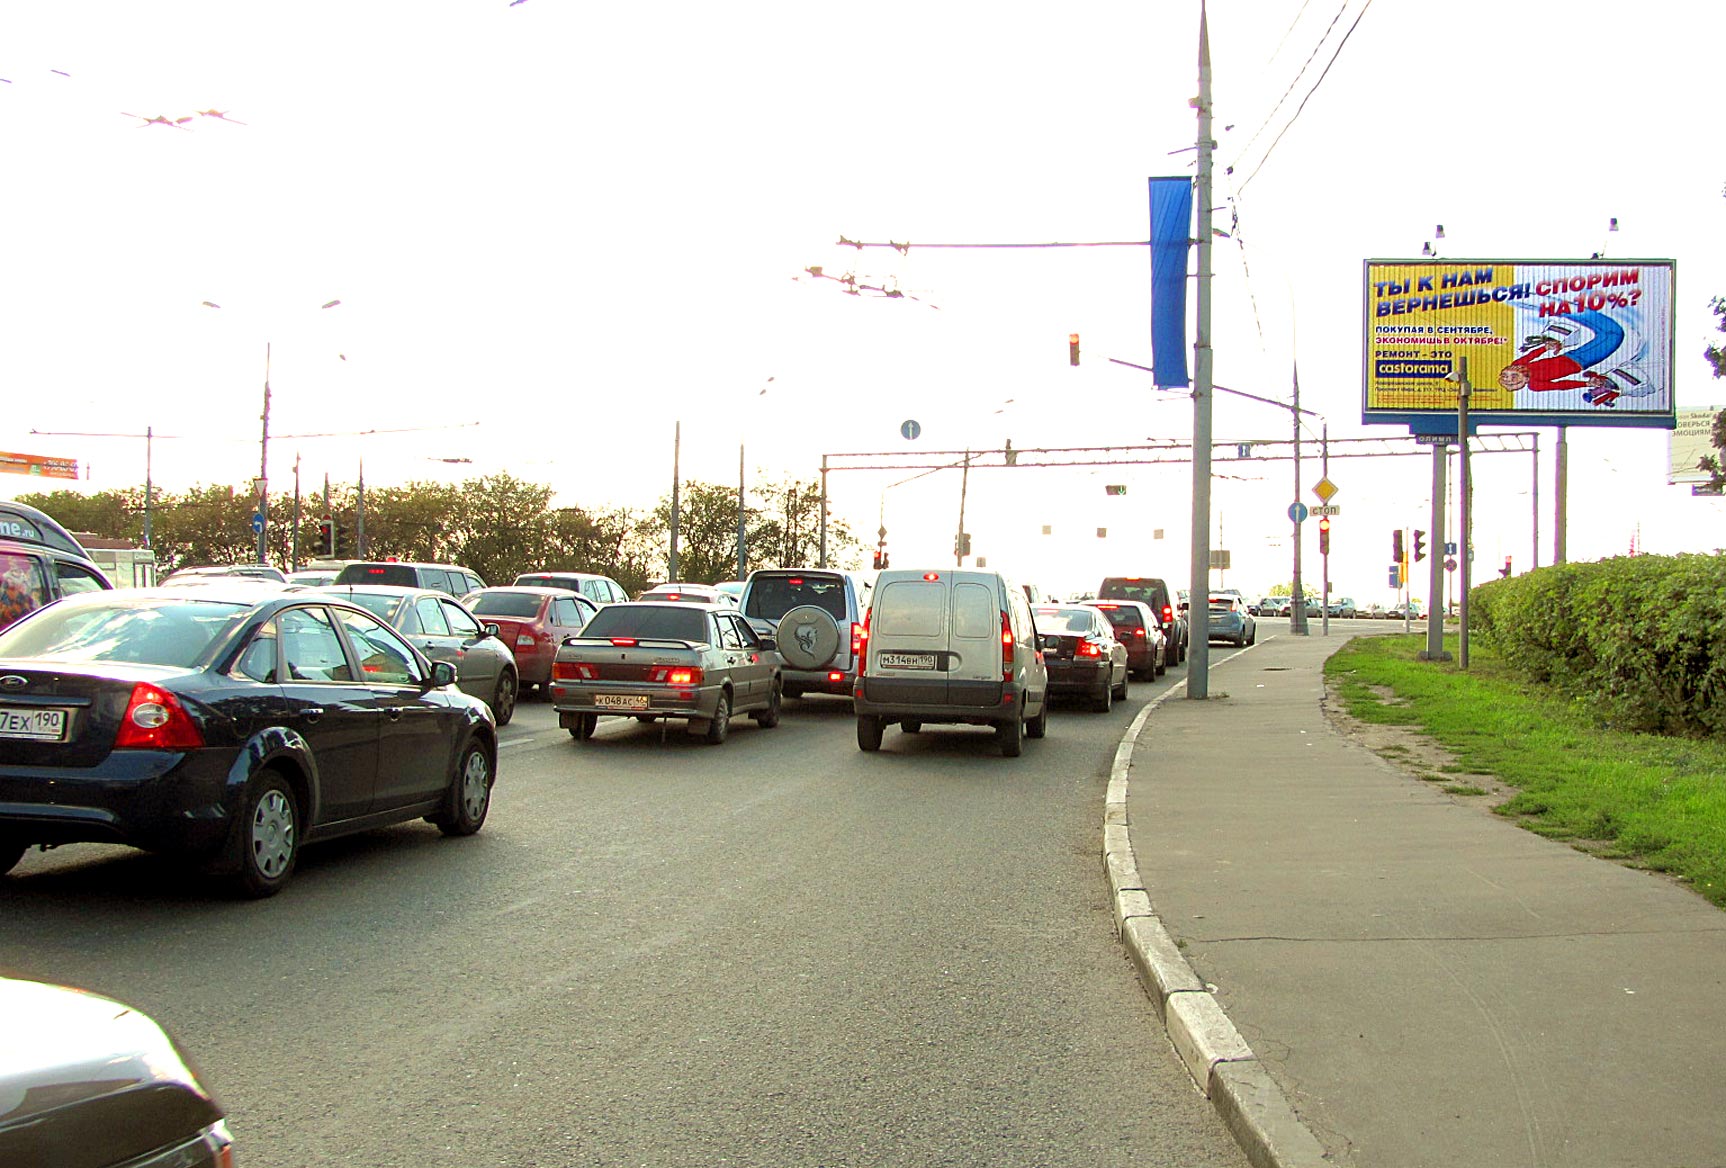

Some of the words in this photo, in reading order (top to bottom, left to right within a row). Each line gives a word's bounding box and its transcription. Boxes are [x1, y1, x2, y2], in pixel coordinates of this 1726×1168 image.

[1375, 279, 1410, 297] ТЫ
[1418, 275, 1434, 292] К
[1441, 267, 1493, 289] НАМ
[1535, 269, 1639, 296] СПОРИМ
[1376, 283, 1530, 317] ВЕРНЕШЬСЯ!
[1375, 326, 1424, 334] ПОКУПАЯ
[1427, 326, 1434, 334] В
[1437, 326, 1493, 335] СЕНТЯБРЕ,
[1375, 350, 1420, 358] РЕМОНТ
[1430, 350, 1452, 358] ЭТО
[1379, 362, 1448, 374] castorama
[1312, 506, 1337, 515] СТОП
[34, 712, 60, 727] 190
